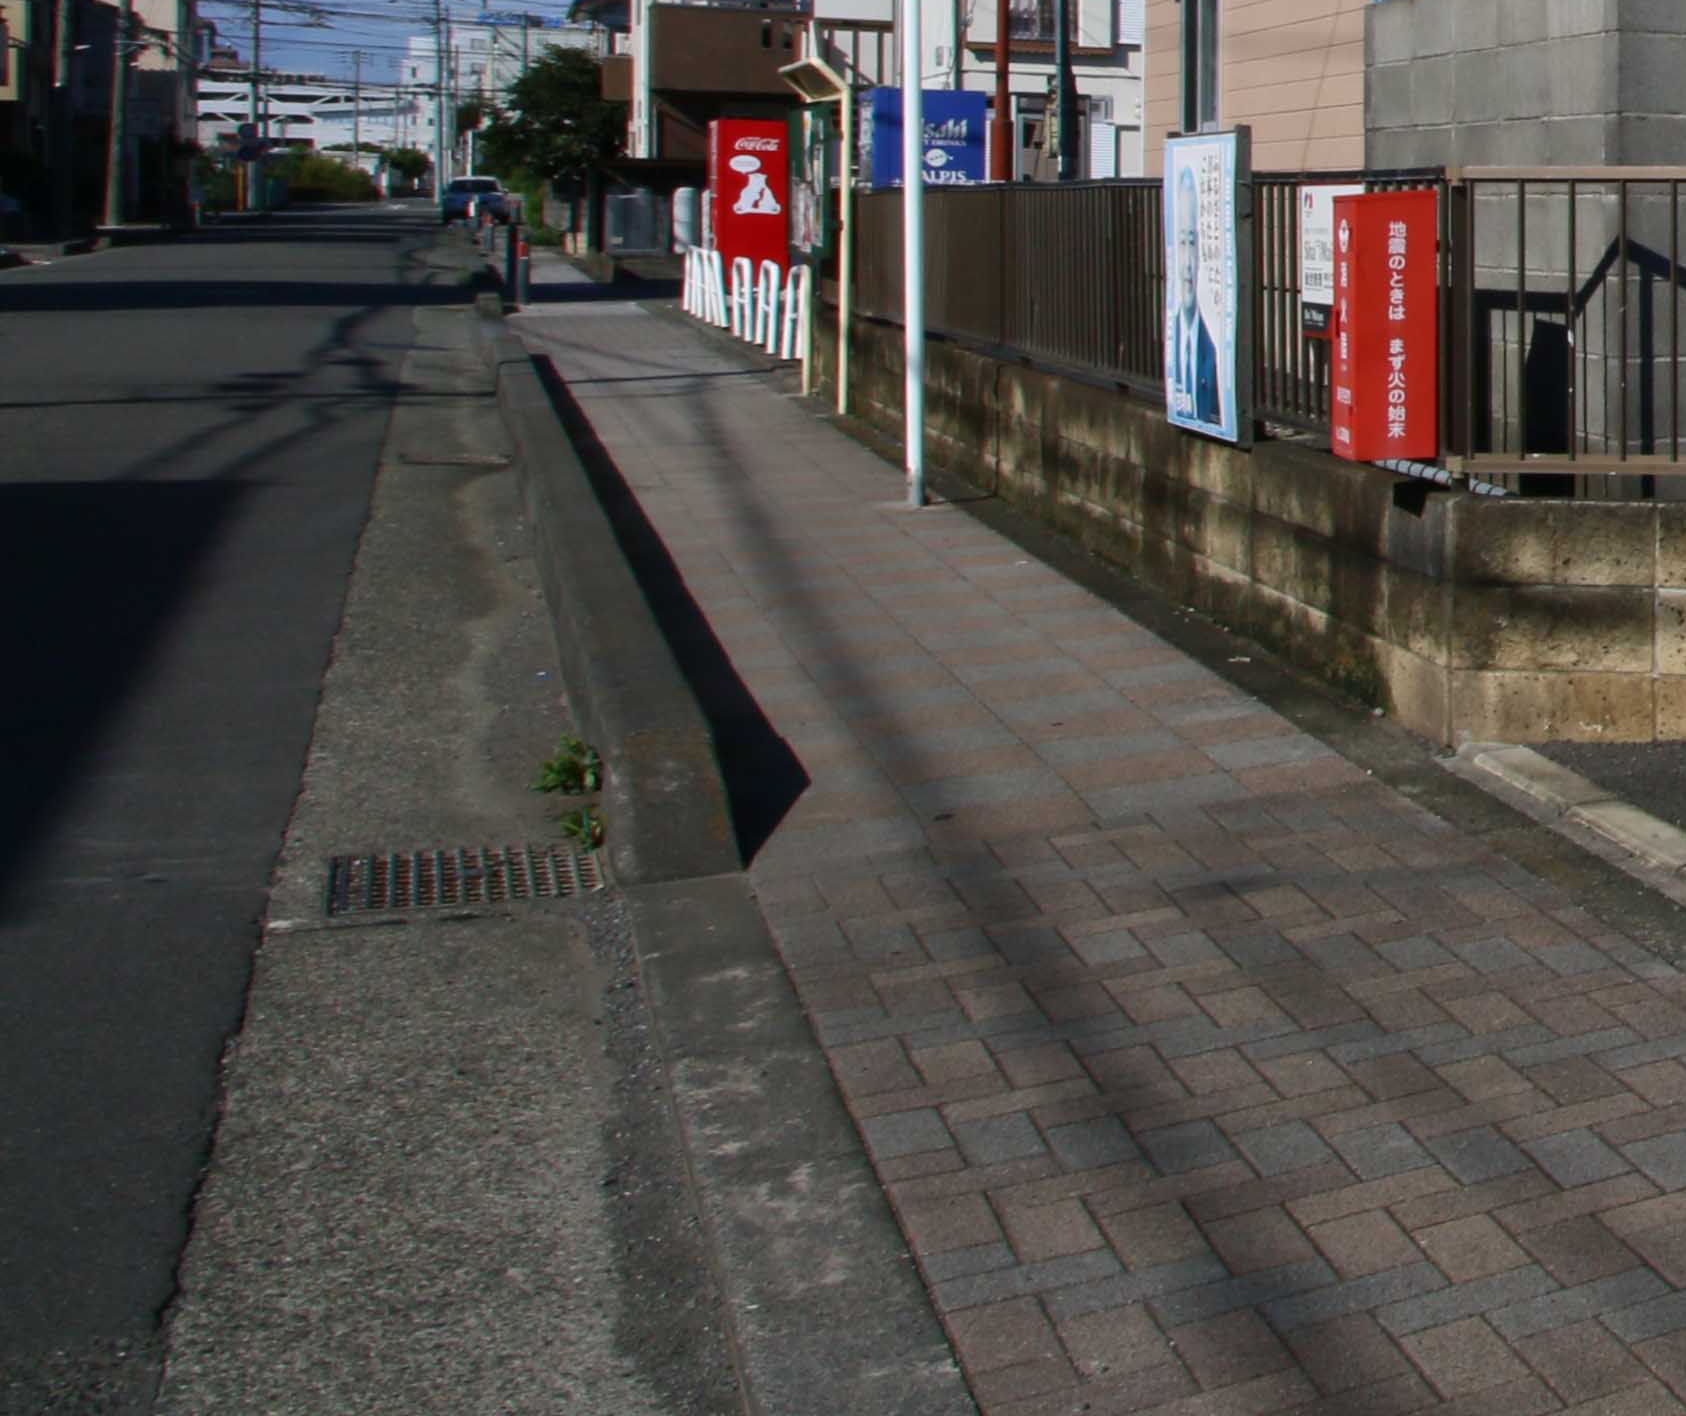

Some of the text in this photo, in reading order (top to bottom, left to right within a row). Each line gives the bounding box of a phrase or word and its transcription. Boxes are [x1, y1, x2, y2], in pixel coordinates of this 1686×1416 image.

[1387, 221, 1407, 438] 地震のときは まず火の始末
